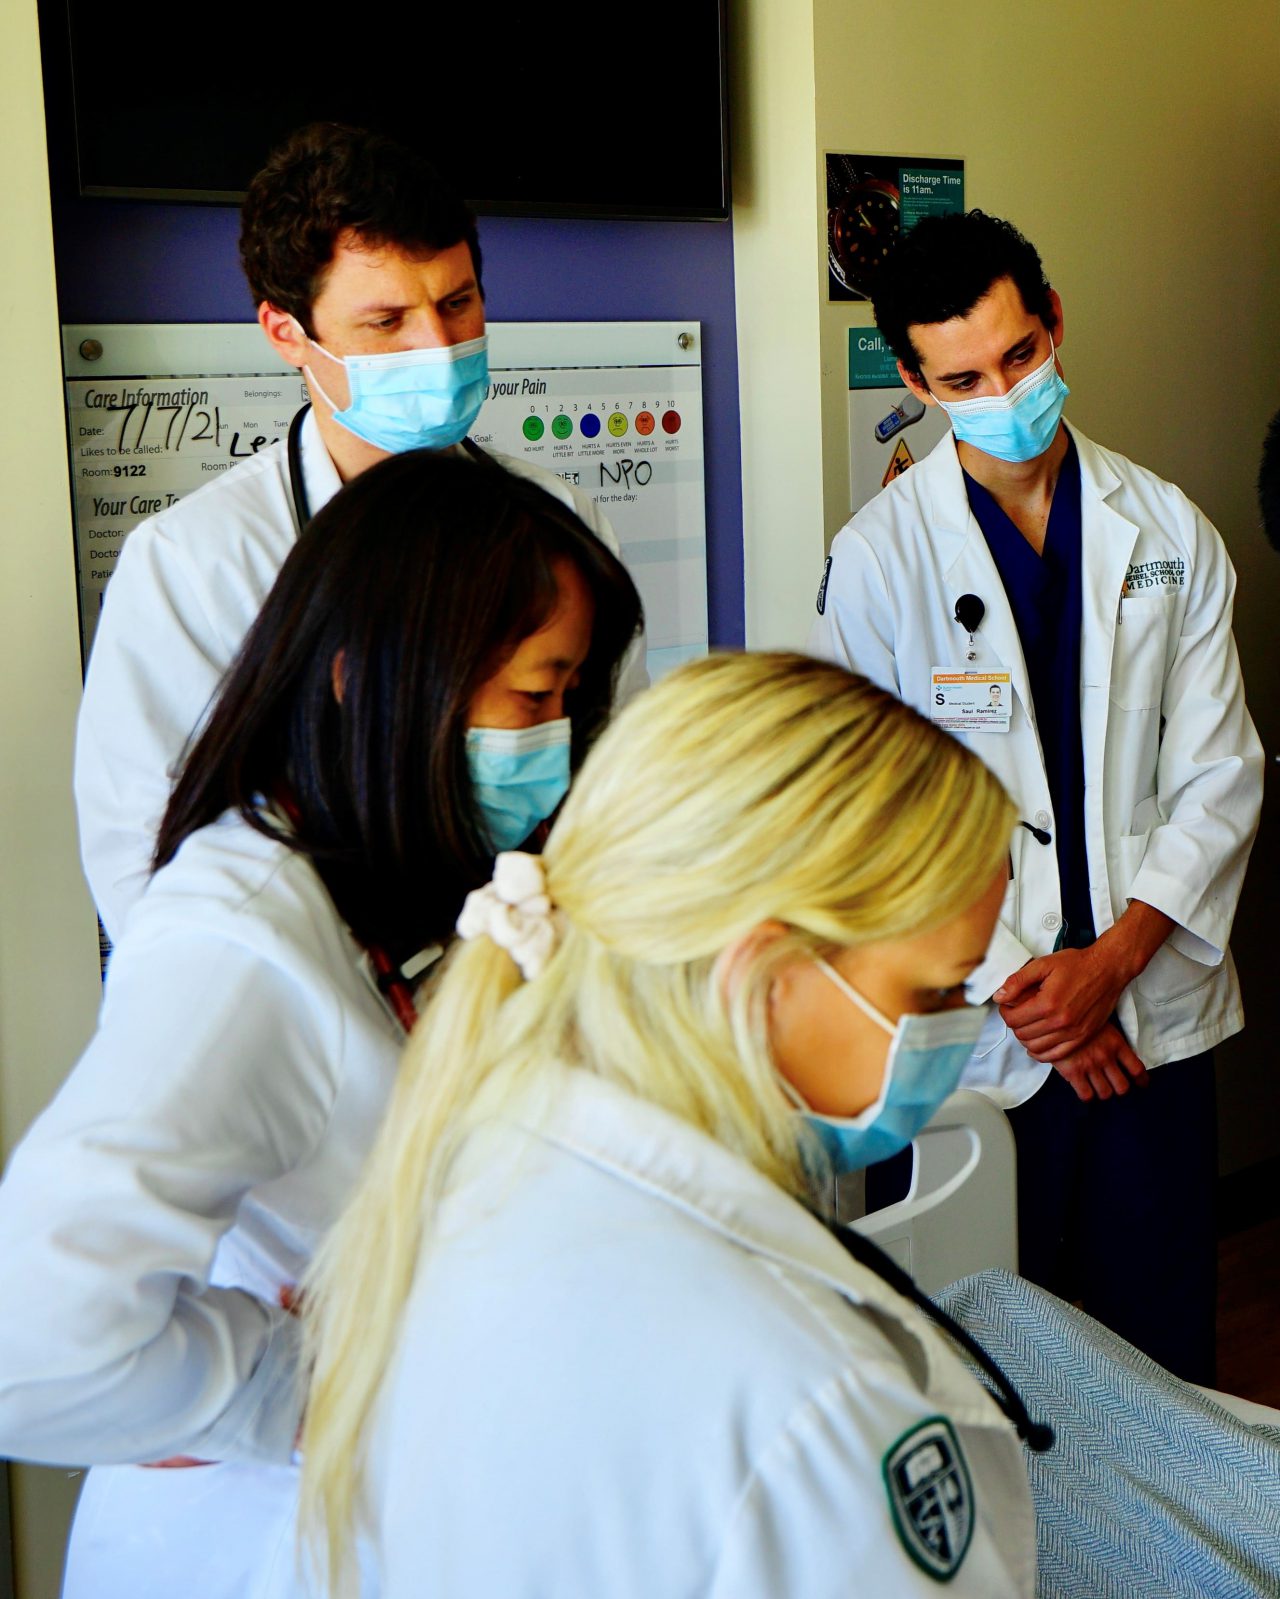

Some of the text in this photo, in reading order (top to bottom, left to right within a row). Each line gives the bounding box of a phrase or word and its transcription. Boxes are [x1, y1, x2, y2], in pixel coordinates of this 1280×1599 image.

[903, 174, 960, 186] Discharge Time
[903, 185, 934, 194] is 11am.
[858, 338, 884, 352] Call,
[244, 390, 282, 398] Belongings:
[492, 383, 519, 400] your
[522, 378, 546, 394] Pain
[85, 388, 208, 408] Care Information
[560, 404, 564, 412] 2
[667, 400, 675, 408] 10
[106, 400, 220, 454] 7/7/21
[273, 420, 288, 428] Tues
[80, 427, 104, 436] Date:
[81, 448, 104, 456] Likes
[107, 448, 116, 456] to
[134, 445, 163, 454] called:
[82, 465, 146, 478] Room: 9122
[202, 462, 228, 471] Room
[600, 458, 652, 490] NPO
[600, 495, 610, 503] for
[611, 494, 622, 502] the
[623, 493, 638, 503] day:
[93, 498, 126, 516] Your
[130, 496, 162, 514] Care
[88, 530, 124, 539] Doctor:
[1126, 557, 1184, 575] Dartmouth
[1150, 570, 1175, 578] SCHOOL
[1126, 576, 1184, 590] MEDICINE
[936, 693, 945, 706] S
